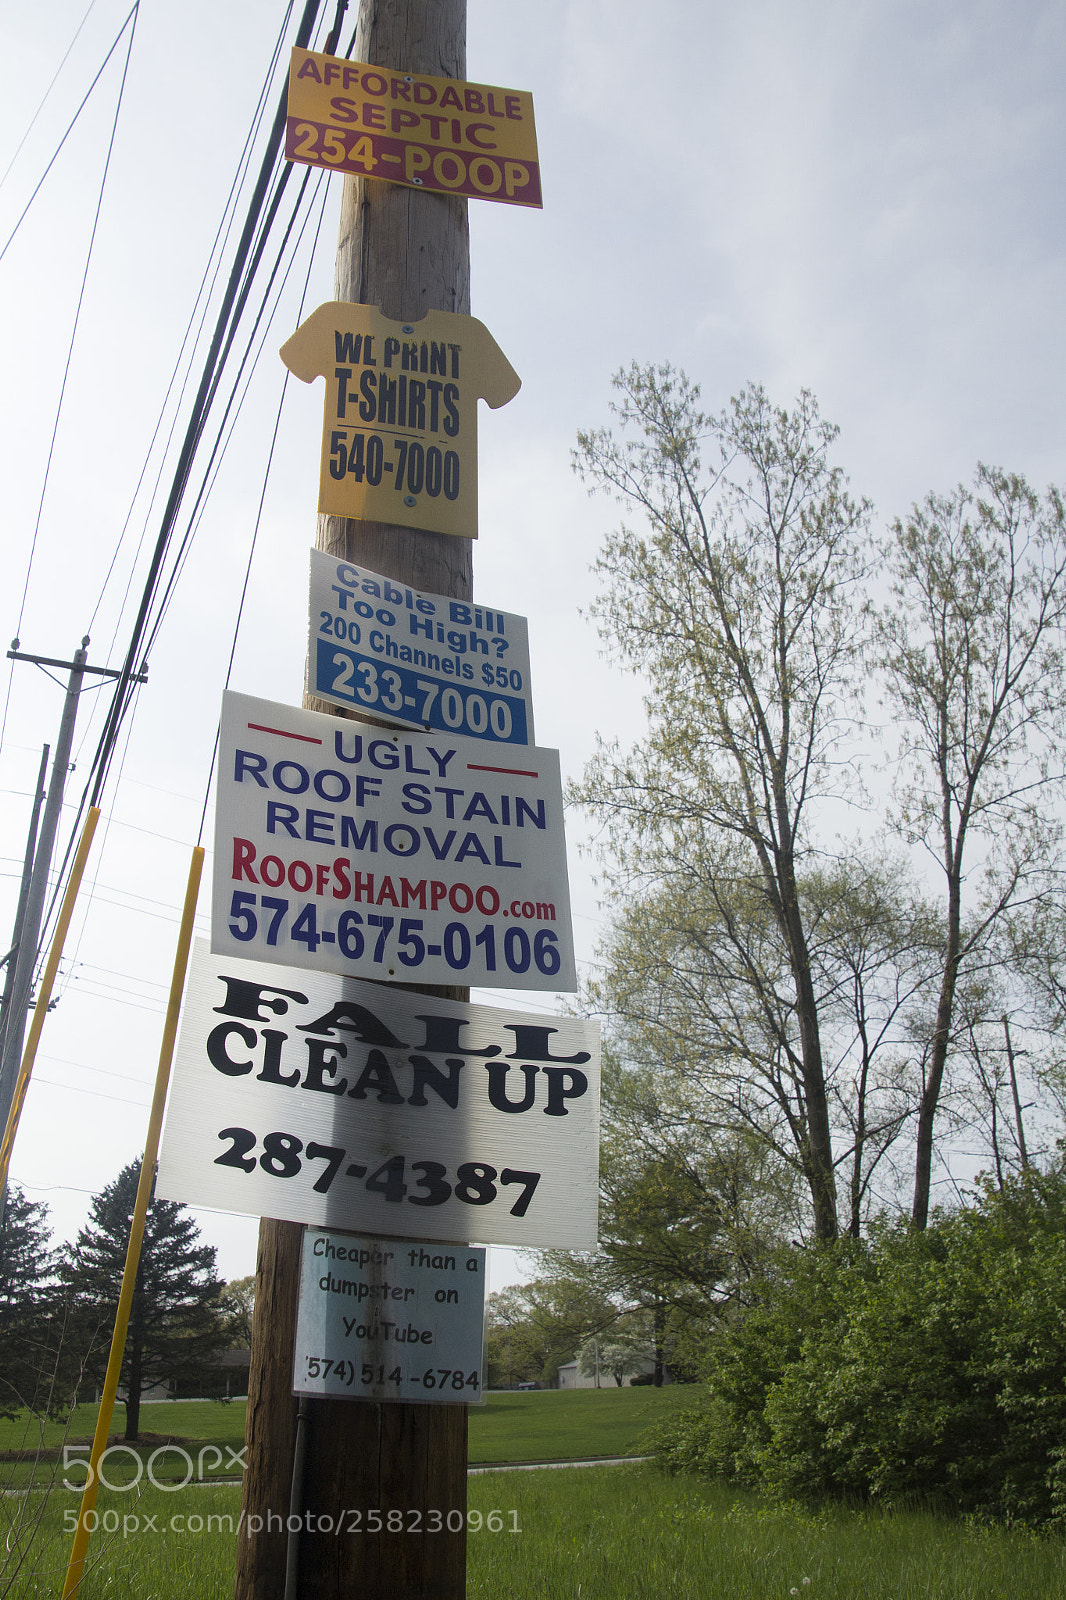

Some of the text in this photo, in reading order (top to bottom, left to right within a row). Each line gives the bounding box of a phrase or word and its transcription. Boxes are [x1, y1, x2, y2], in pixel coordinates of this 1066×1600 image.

[297, 58, 523, 120] AFFORDABLE
[330, 97, 497, 149] SEPTIC
[293, 123, 530, 196] 254-POOP
[383, 336, 462, 379] PRINT
[334, 368, 460, 437] T-SHIRTS
[329, 431, 460, 501] 540-7000
[331, 585, 510, 659] Too High?
[336, 564, 505, 635] Cable Bill
[319, 611, 523, 692] 200 Channels $50
[331, 652, 513, 739] 233-7000
[234, 748, 547, 830] ROOF STAIN
[334, 730, 457, 778] UGLY
[266, 800, 522, 869] REMOVAL
[228, 889, 561, 976] 574-675-0106
[212, 975, 592, 1063] FALL
[206, 1021, 589, 1117] CLEAN UP
[213, 1127, 541, 1217] 287-4387
[313, 1238, 478, 1272] Cheaper than a
[319, 1272, 459, 1304] dumpster on
[342, 1316, 433, 1345] YouTube
[305, 1355, 355, 1386] 574)
